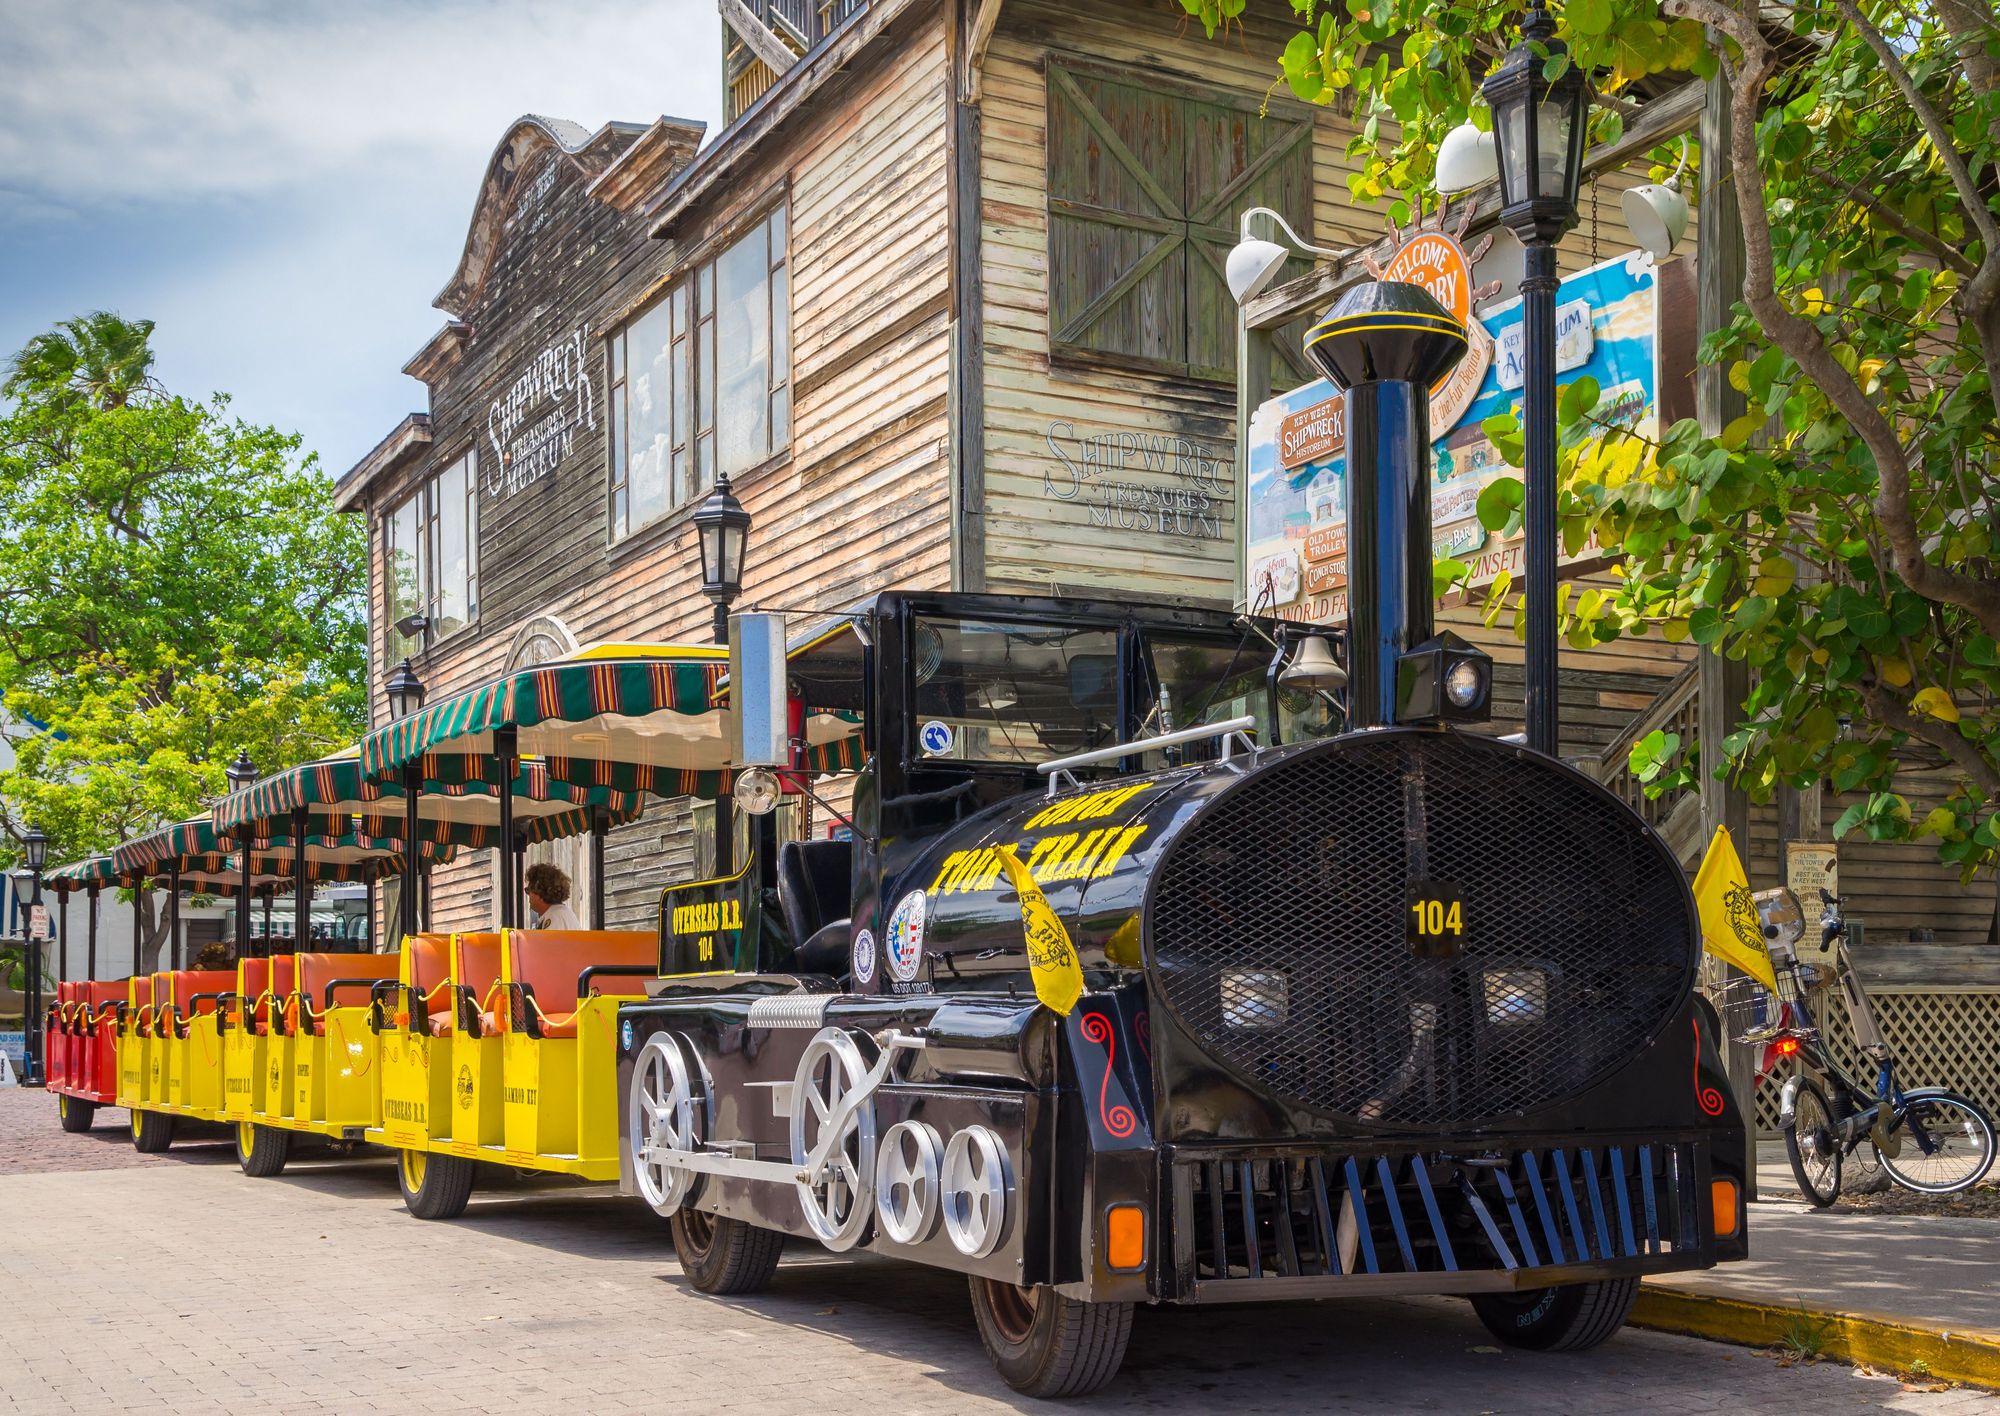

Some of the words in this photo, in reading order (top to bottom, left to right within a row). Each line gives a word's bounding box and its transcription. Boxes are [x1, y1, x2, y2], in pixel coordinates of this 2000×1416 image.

[1411, 271, 1425, 285] TO
[1503, 333, 1521, 349] KEY
[1438, 400, 1452, 420] the
[1448, 384, 1465, 407] Fun
[1459, 348, 1482, 386] Begins
[487, 323, 597, 498] SHIPWRECK
[1294, 413, 1308, 427] KEY
[1310, 403, 1331, 421] WEST
[511, 405, 566, 465] TREASURES
[1284, 410, 1344, 459] SHIPWRECK
[1296, 437, 1331, 459] HISTOREUM
[507, 425, 574, 499] MUSEUM
[1044, 420, 1236, 500] SHIPWREC
[1100, 479, 1210, 511] TREASURES
[1087, 499, 1222, 539] MUSEUM
[1309, 533, 1324, 547] OLD
[1310, 539, 1347, 556] TROLLEY
[1432, 531, 1449, 542] SLAND
[1309, 564, 1329, 589] CONCH
[1329, 560, 1348, 576] STOR
[1283, 598, 1329, 622] WORLD
[1023, 782, 1154, 831] CONCH
[926, 842, 1018, 897] TOUR
[1026, 824, 1149, 883] TRAIN
[673, 902, 719, 936] OVERSEAS
[721, 899, 743, 931] R.R.
[1412, 900, 1463, 936] 104
[698, 935, 713, 962] 104
[899, 983, 911, 994] DOT
[385, 1099, 412, 1123] OVERSEAS
[1517, 1286, 1559, 1328] NEX
